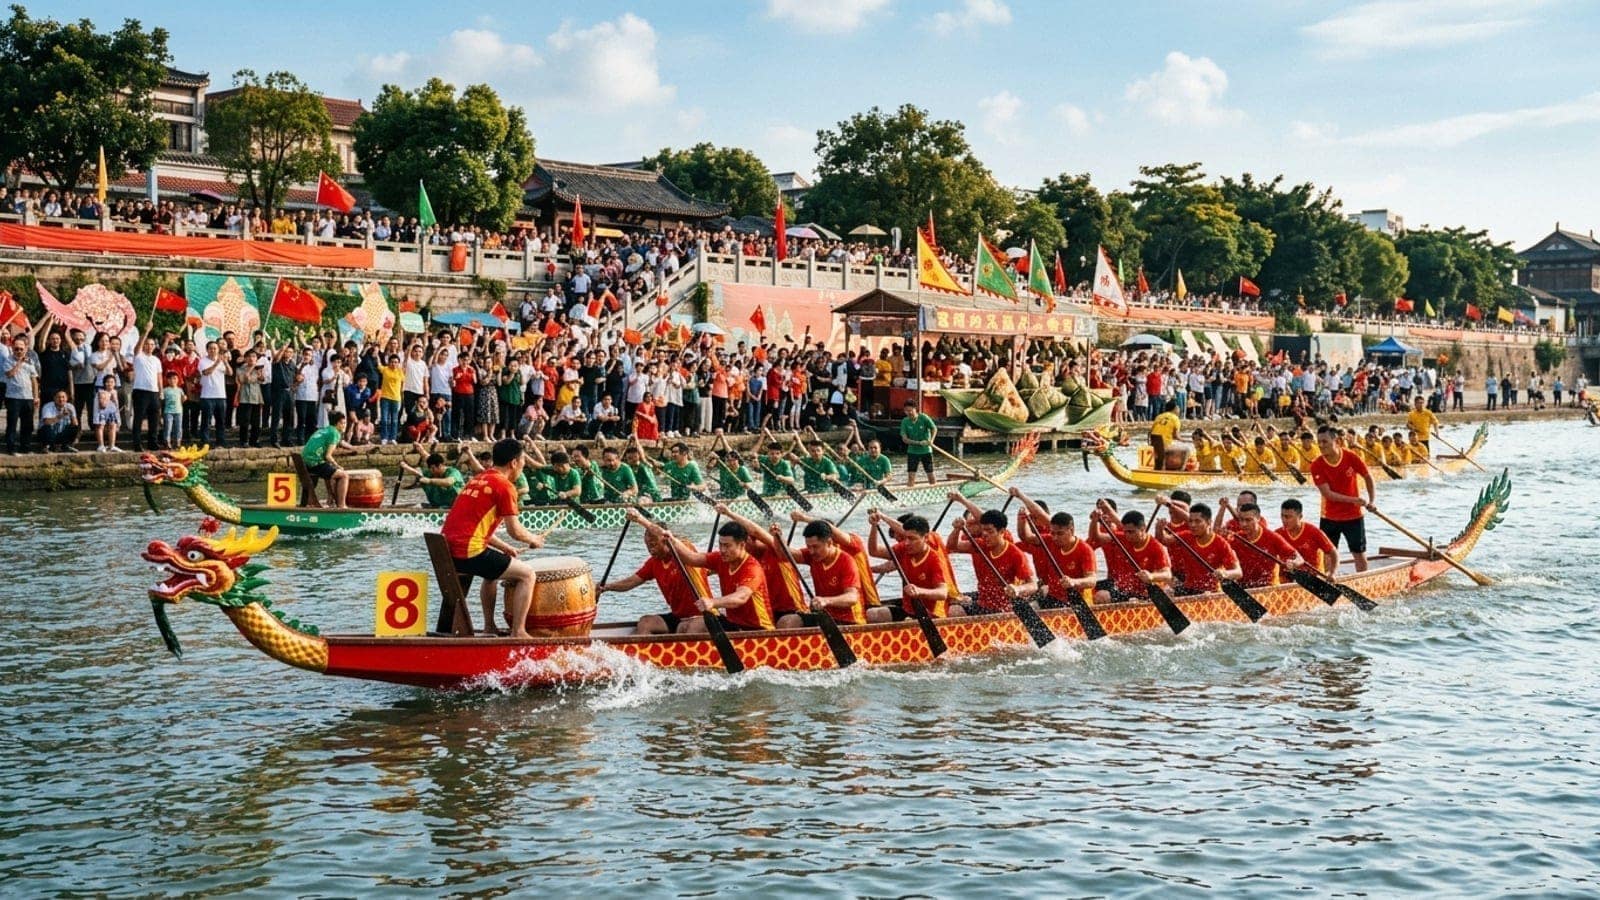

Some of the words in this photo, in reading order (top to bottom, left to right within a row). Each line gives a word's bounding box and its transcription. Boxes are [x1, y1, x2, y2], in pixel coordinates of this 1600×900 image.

[1140, 450, 1153, 467] 12
[273, 477, 291, 503] 5
[384, 577, 420, 630] 8
